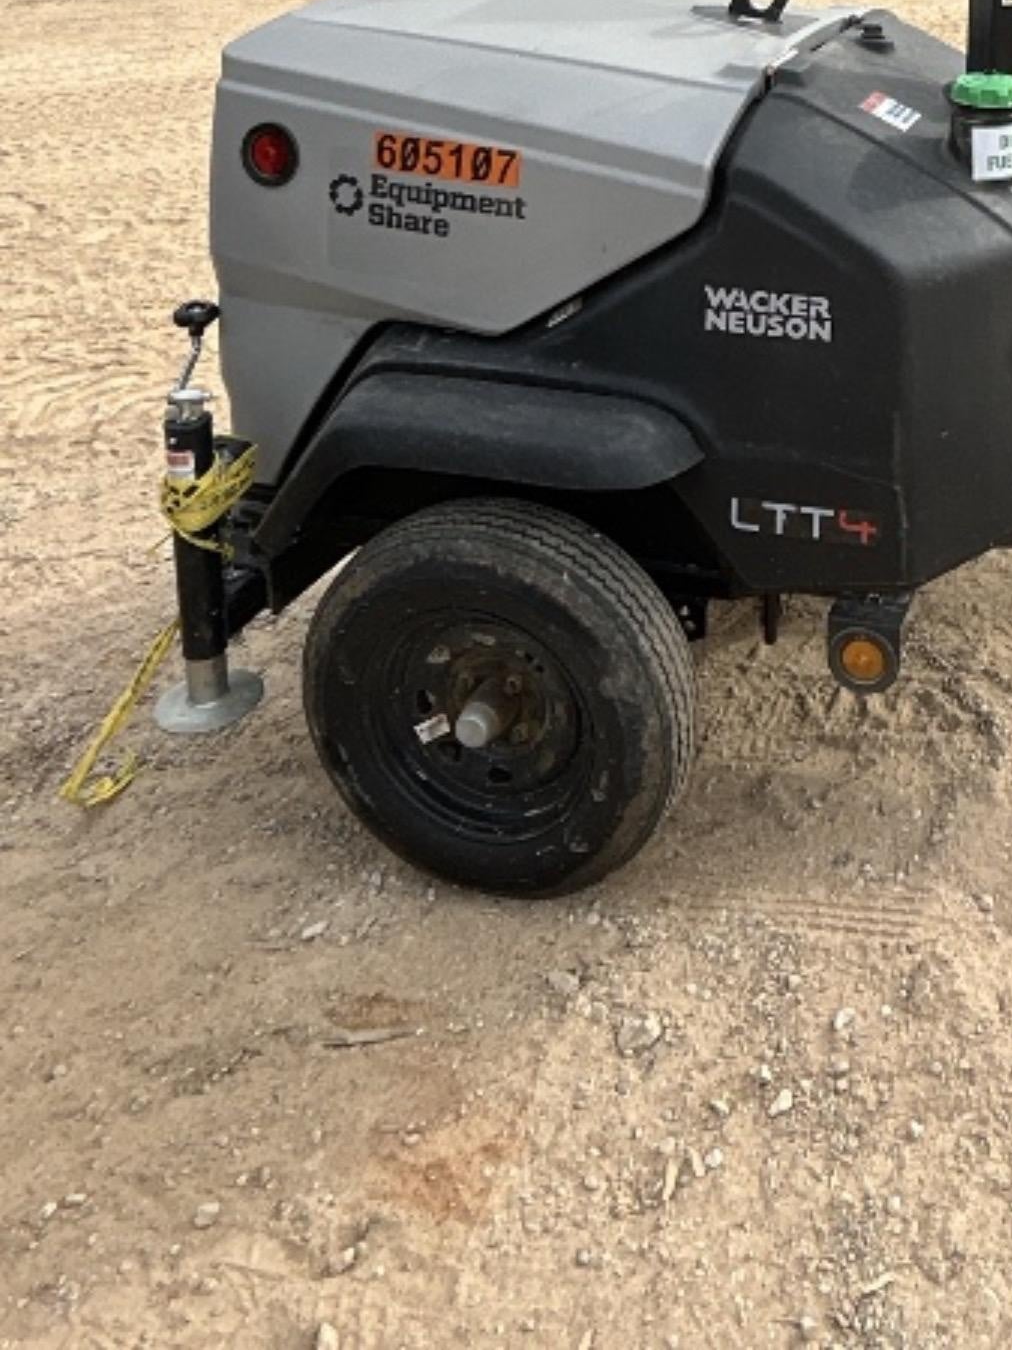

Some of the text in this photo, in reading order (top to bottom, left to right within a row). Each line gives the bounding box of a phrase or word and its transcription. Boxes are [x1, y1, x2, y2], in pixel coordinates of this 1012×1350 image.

[376, 133, 517, 184] 605107
[368, 173, 528, 220] Equipment
[367, 203, 450, 238] Share
[704, 283, 831, 320] WACKER
[704, 308, 833, 343] NEUSON
[730, 497, 877, 545] LTT4
